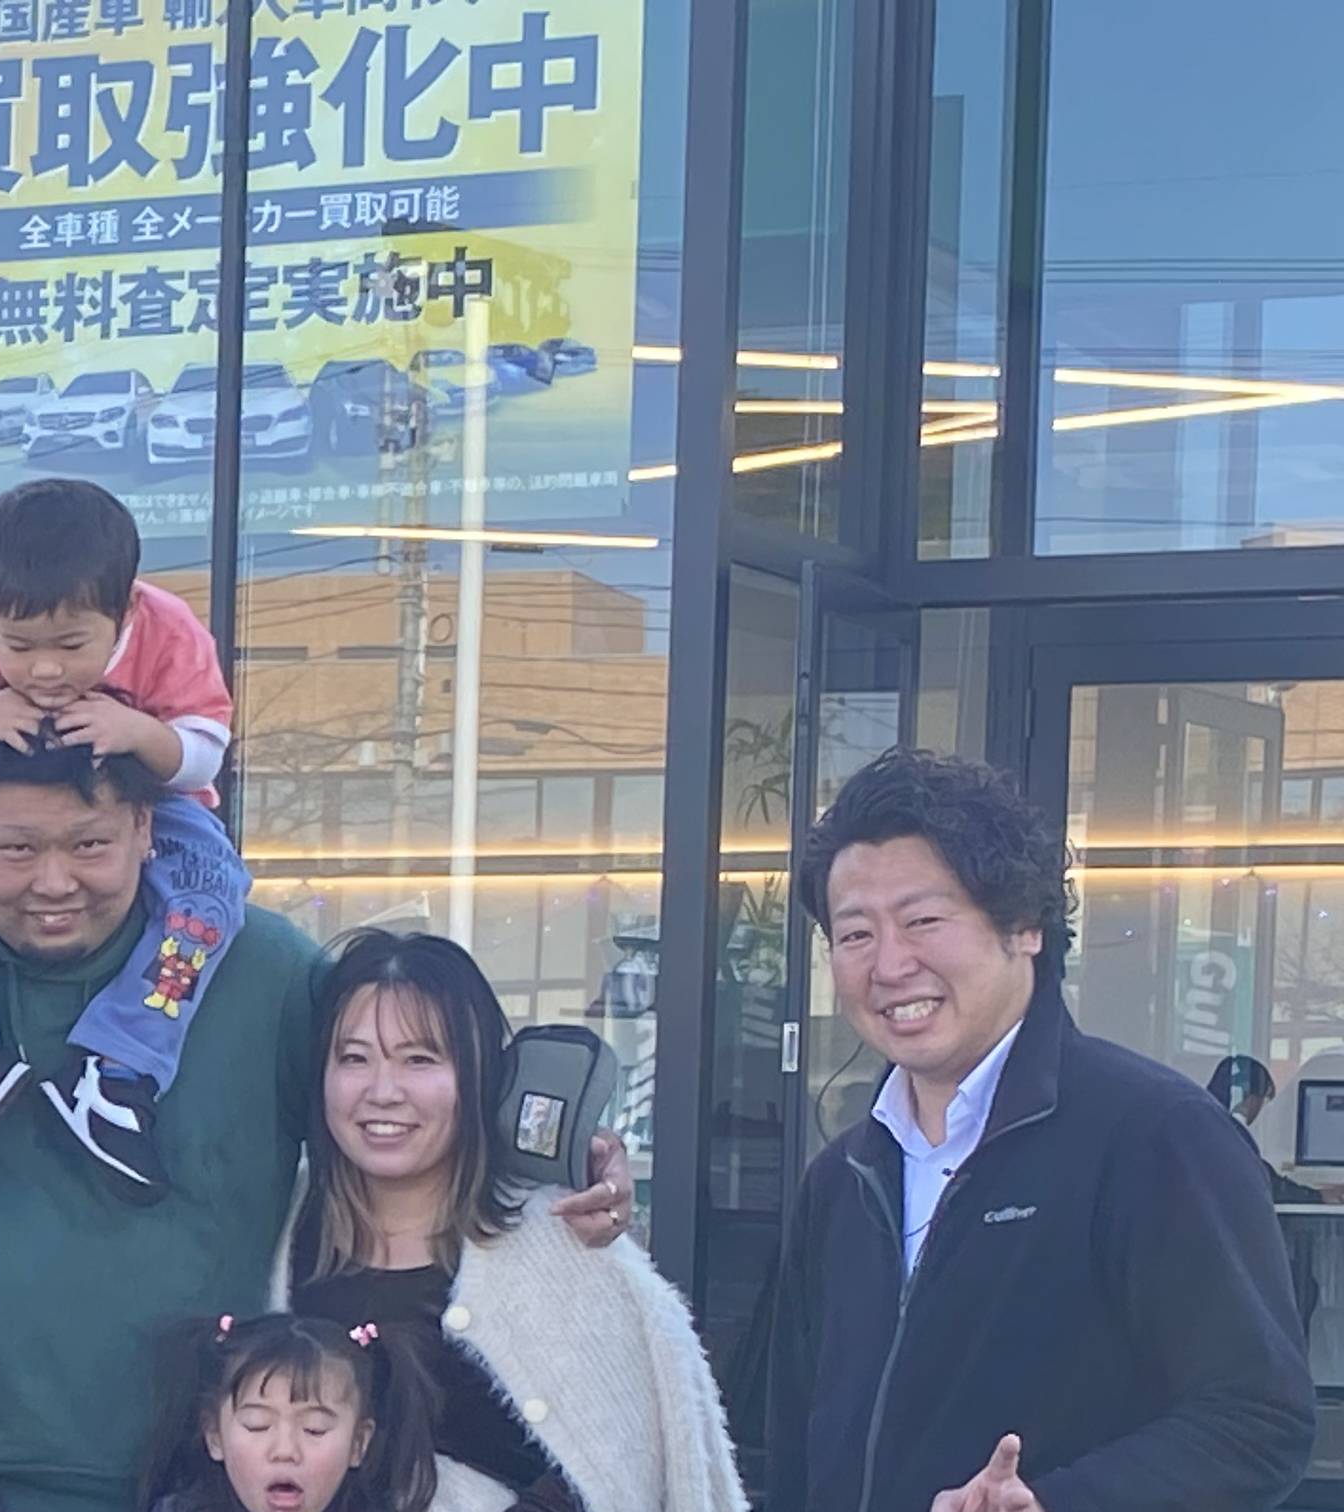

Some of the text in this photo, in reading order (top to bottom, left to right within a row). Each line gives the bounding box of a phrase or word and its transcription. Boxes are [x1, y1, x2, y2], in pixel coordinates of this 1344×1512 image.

[18, 185, 461, 251] 全車種 全メーカー買取可能
